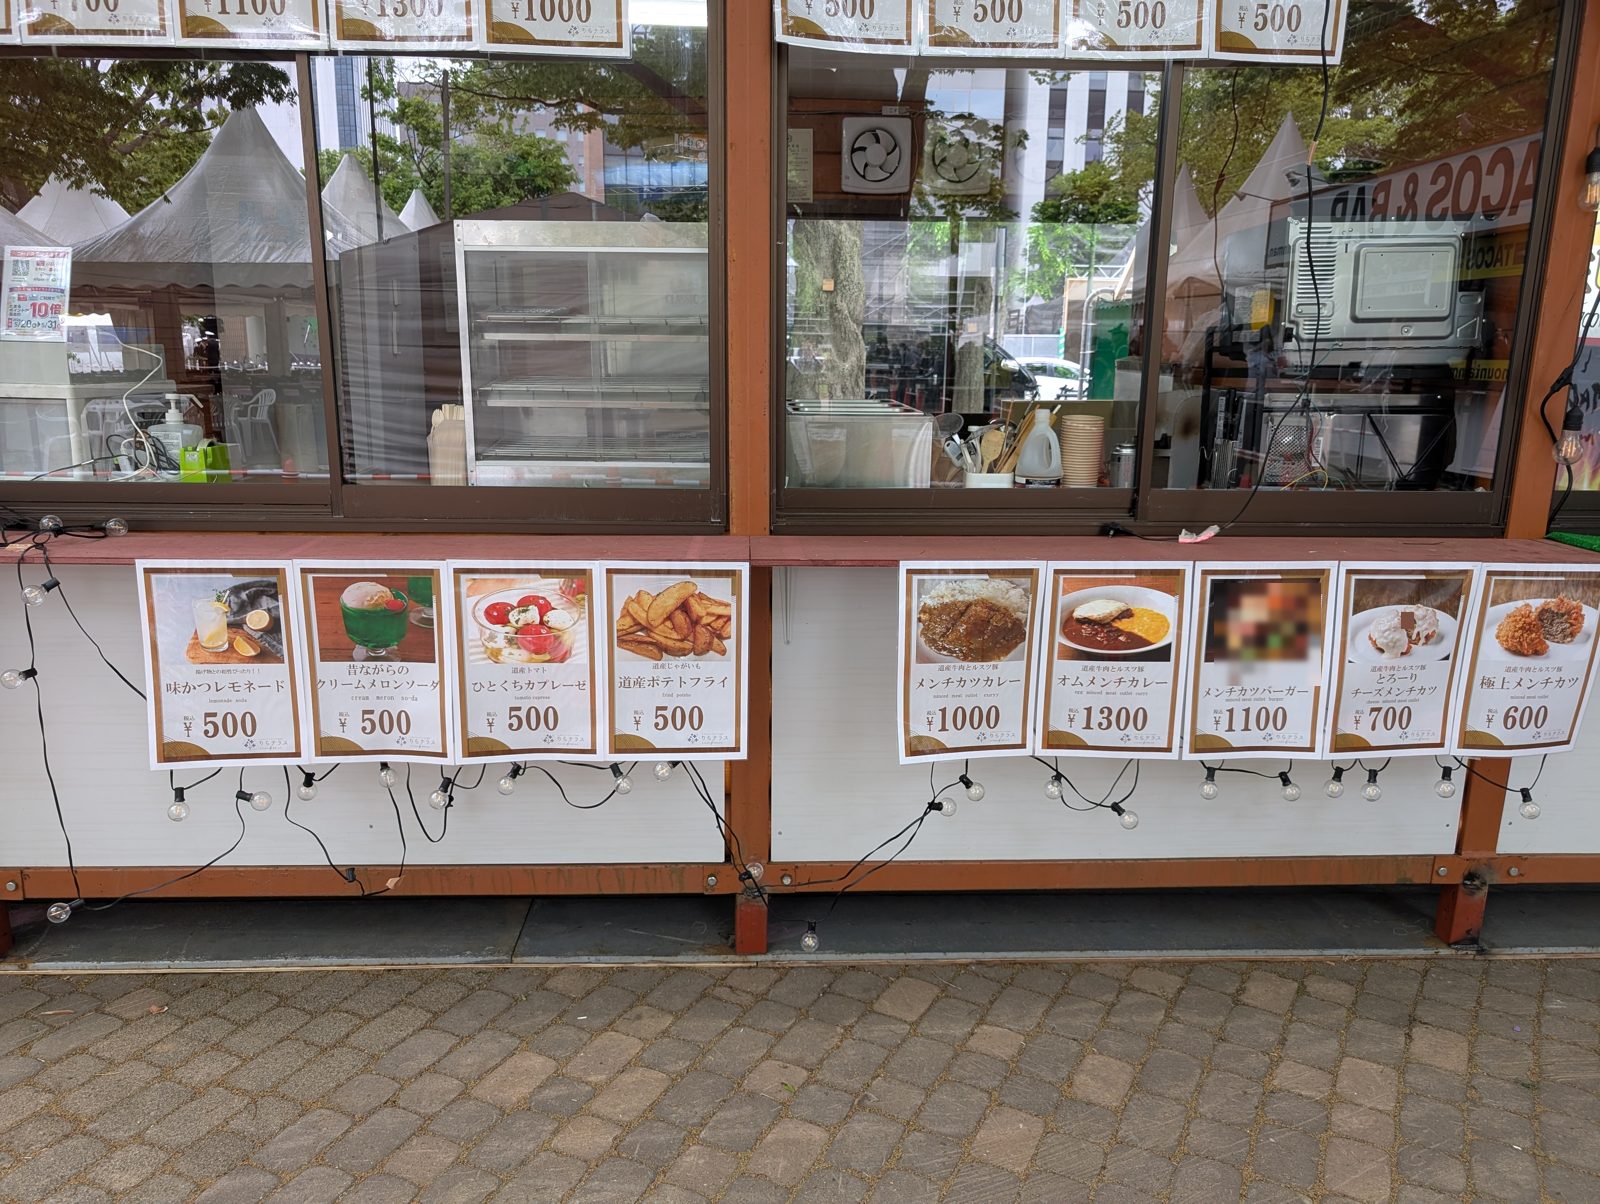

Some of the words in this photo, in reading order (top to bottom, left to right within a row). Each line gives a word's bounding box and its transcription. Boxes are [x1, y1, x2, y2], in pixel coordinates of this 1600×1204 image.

[525, 0, 591, 23] 1000
[974, 0, 1023, 23] 500
[1117, 1, 1166, 29] 500
[1254, 4, 1301, 32] 500
[30, 302, 62, 318] 10倍
[347, 664, 409, 676] 昔ながらの
[1058, 675, 1168, 688] オムメンチカレー
[1376, 673, 1417, 684] とろーり
[166, 680, 285, 694] 味かつレモネード
[619, 676, 728, 689] 道産ポテトフライ
[916, 677, 1021, 689] メンチカツカレー
[1203, 686, 1309, 698] メンチカツバーガー
[1351, 686, 1437, 698] チーズメンチカツ
[1480, 675, 1578, 690] 極上メンチカツ
[184, 722, 192, 737] ¥
[203, 711, 257, 738] 500
[339, 718, 347, 733] ¥
[361, 710, 411, 735] 500
[486, 718, 494, 733] ¥
[508, 706, 559, 731] 500
[633, 717, 641, 731] ¥
[654, 706, 704, 731] 500
[927, 717, 933, 731] ¥
[938, 705, 1000, 732] 1000
[1068, 714, 1075, 728] ¥
[1082, 706, 1148, 731] 1300
[1213, 717, 1221, 731] ¥
[1225, 706, 1287, 732] 1100
[1354, 716, 1361, 730] ¥
[1369, 706, 1412, 731] 700
[1486, 714, 1495, 728] ¥
[1503, 705, 1548, 730] 600
